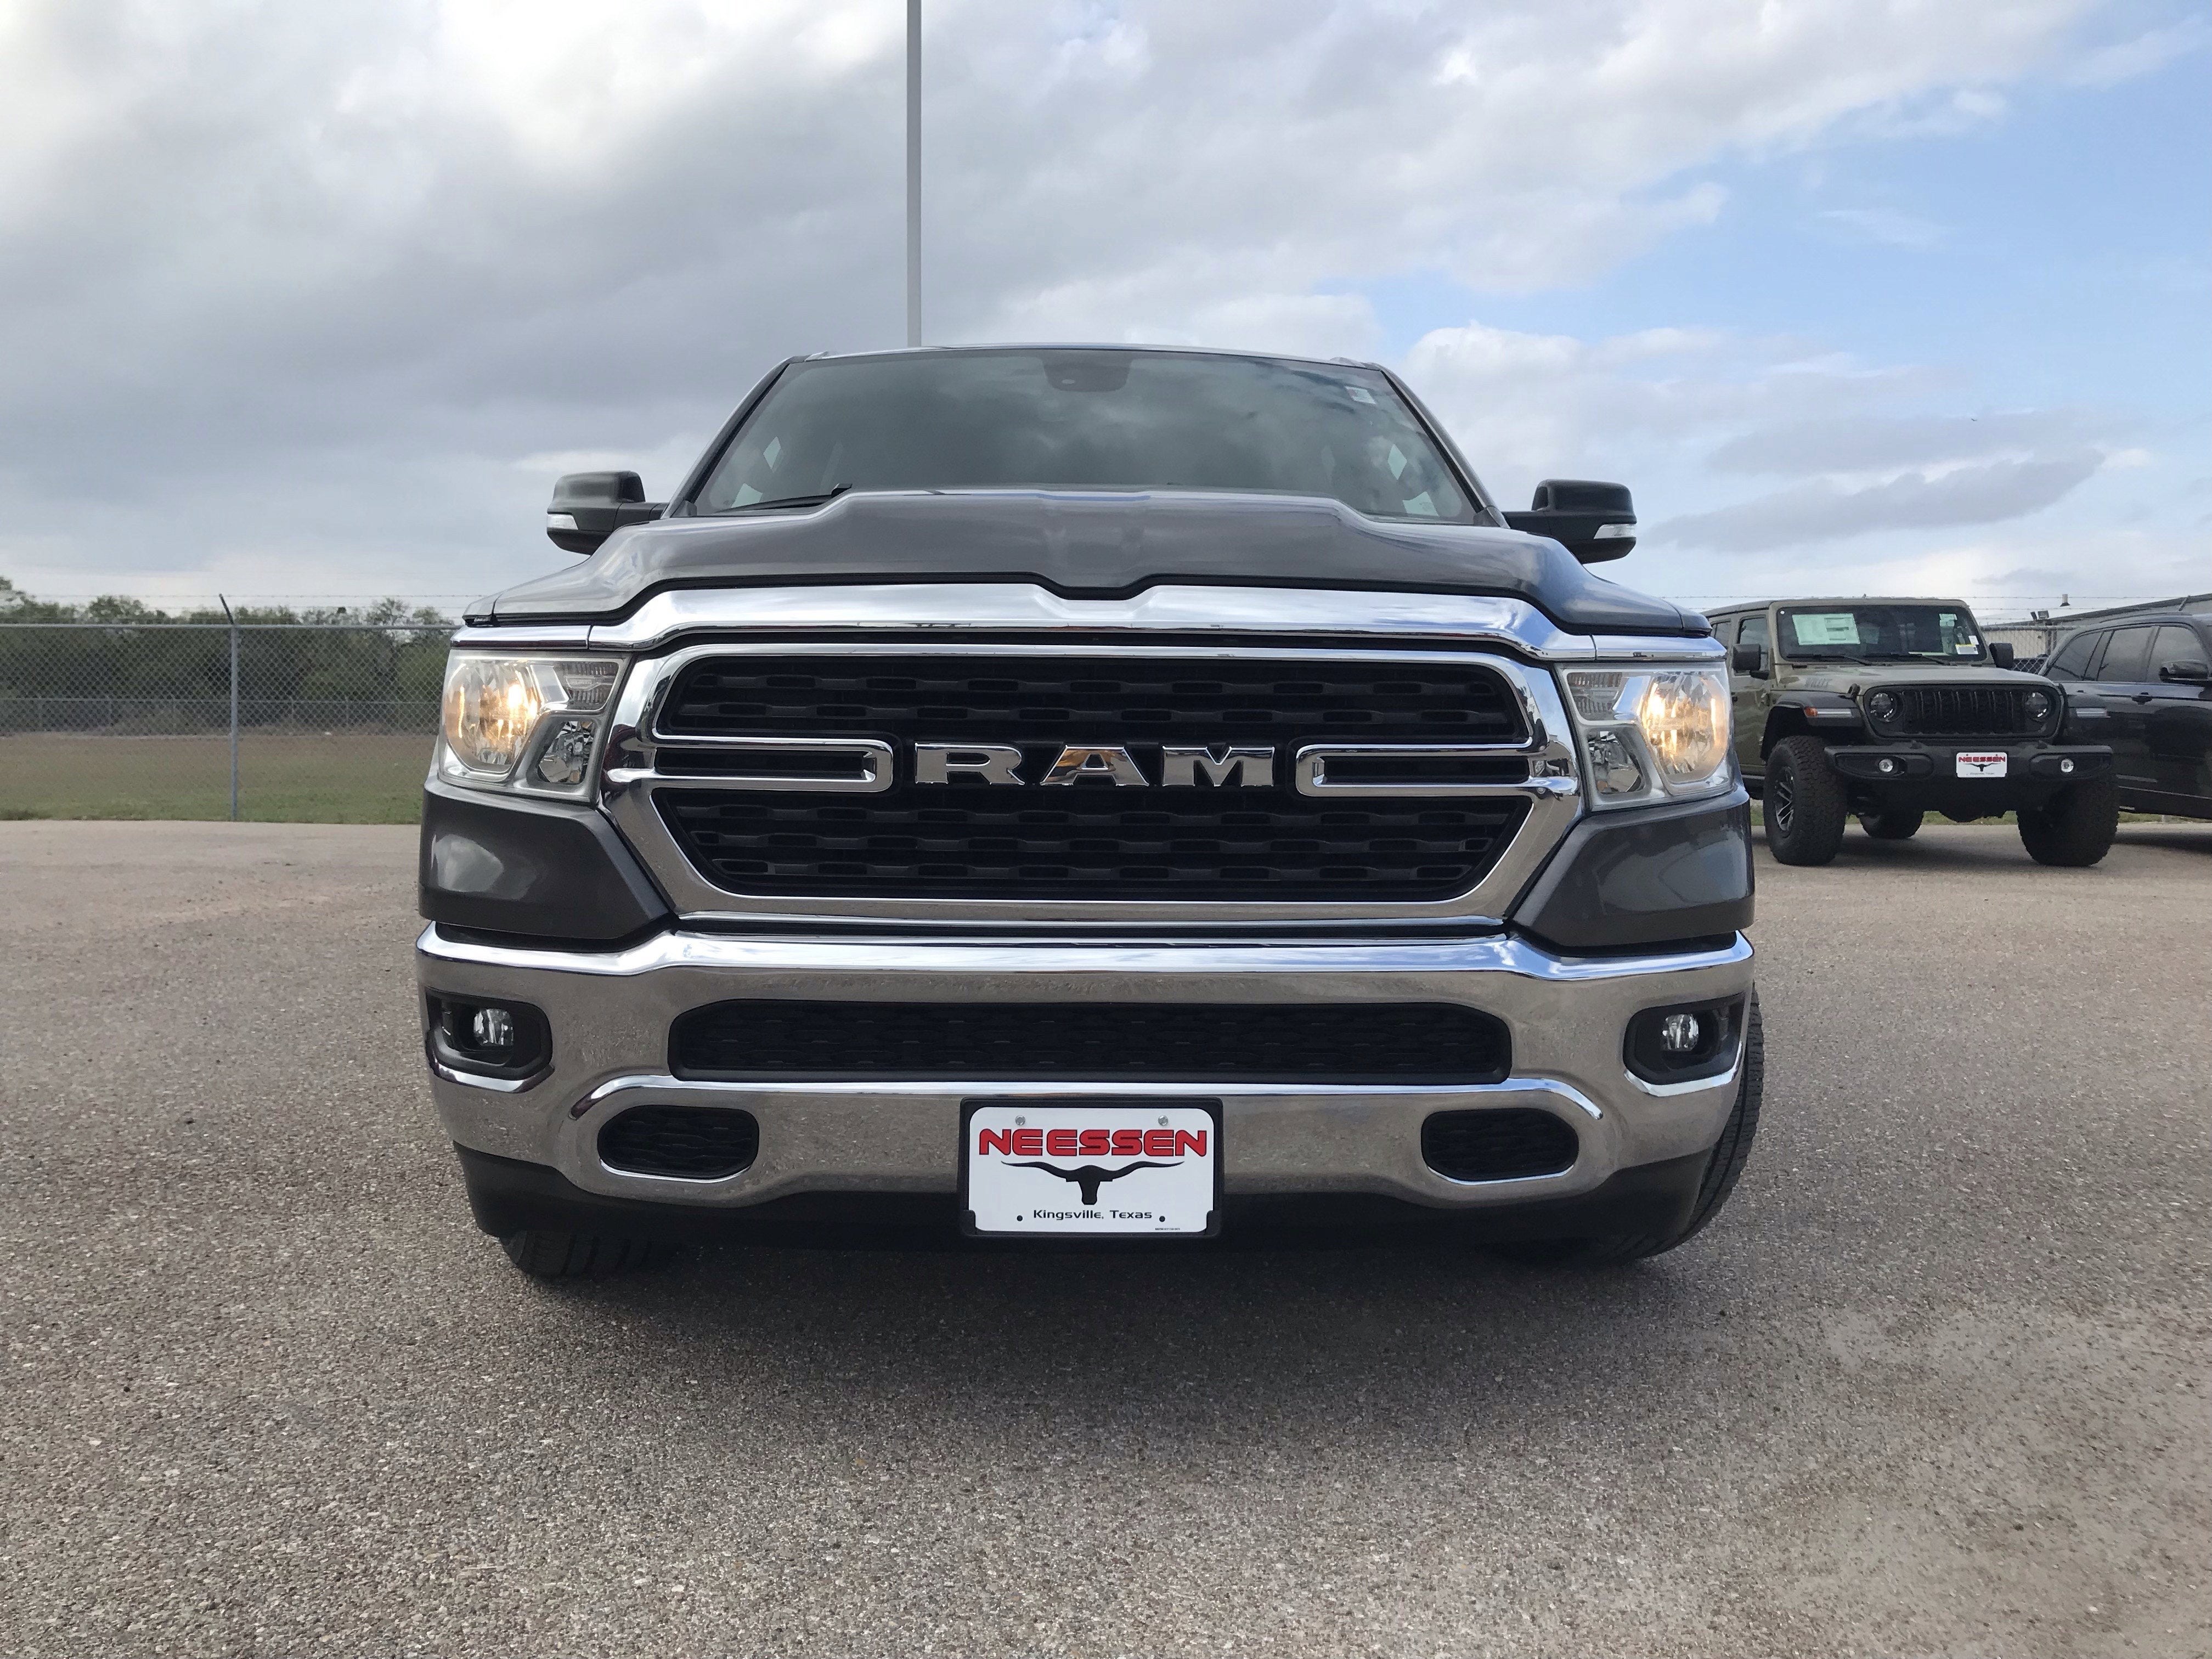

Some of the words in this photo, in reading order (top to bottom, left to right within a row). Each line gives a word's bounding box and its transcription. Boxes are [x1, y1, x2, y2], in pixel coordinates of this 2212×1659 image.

[915, 743, 1275, 787] RAM
[979, 1128, 1207, 1157] NEESSEN
[1034, 1210, 1104, 1221] Kingsville,
[1109, 1210, 1152, 1218] Texas
